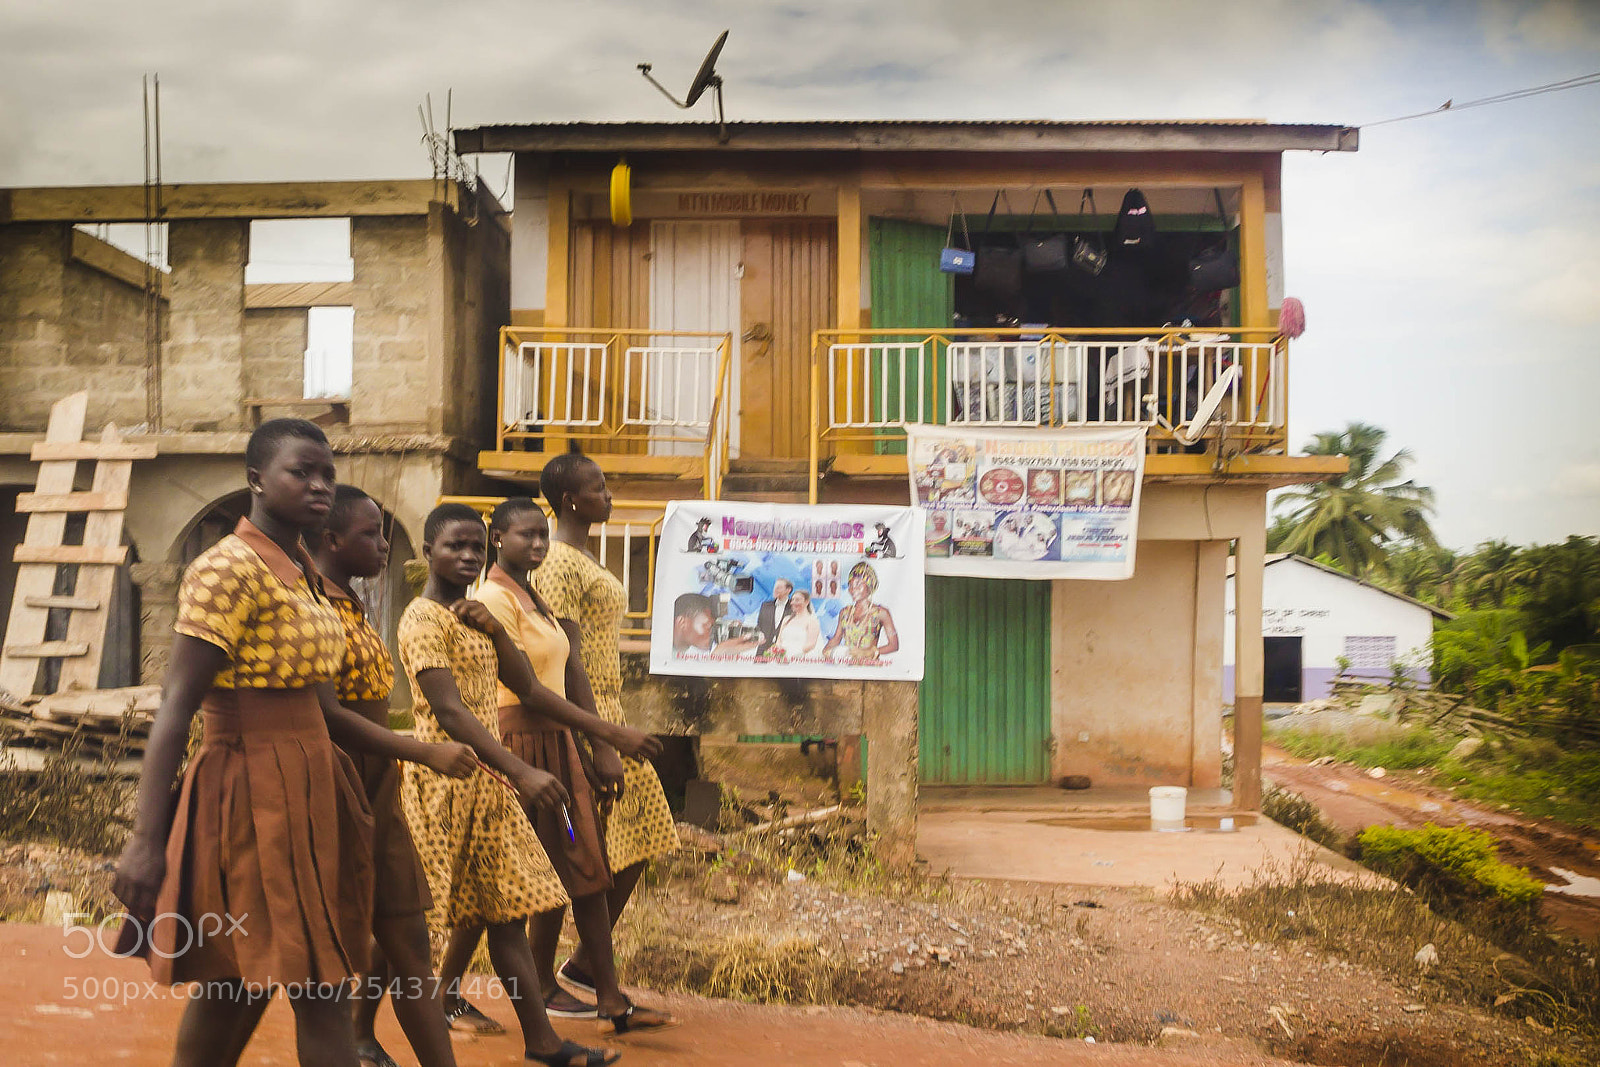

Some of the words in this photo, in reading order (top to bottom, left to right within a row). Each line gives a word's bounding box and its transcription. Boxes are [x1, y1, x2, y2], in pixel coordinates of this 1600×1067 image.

[711, 193, 758, 212] MOBILE
[760, 193, 811, 212] MONEY
[722, 516, 788, 540] Nayak
[789, 519, 865, 541] Photos
